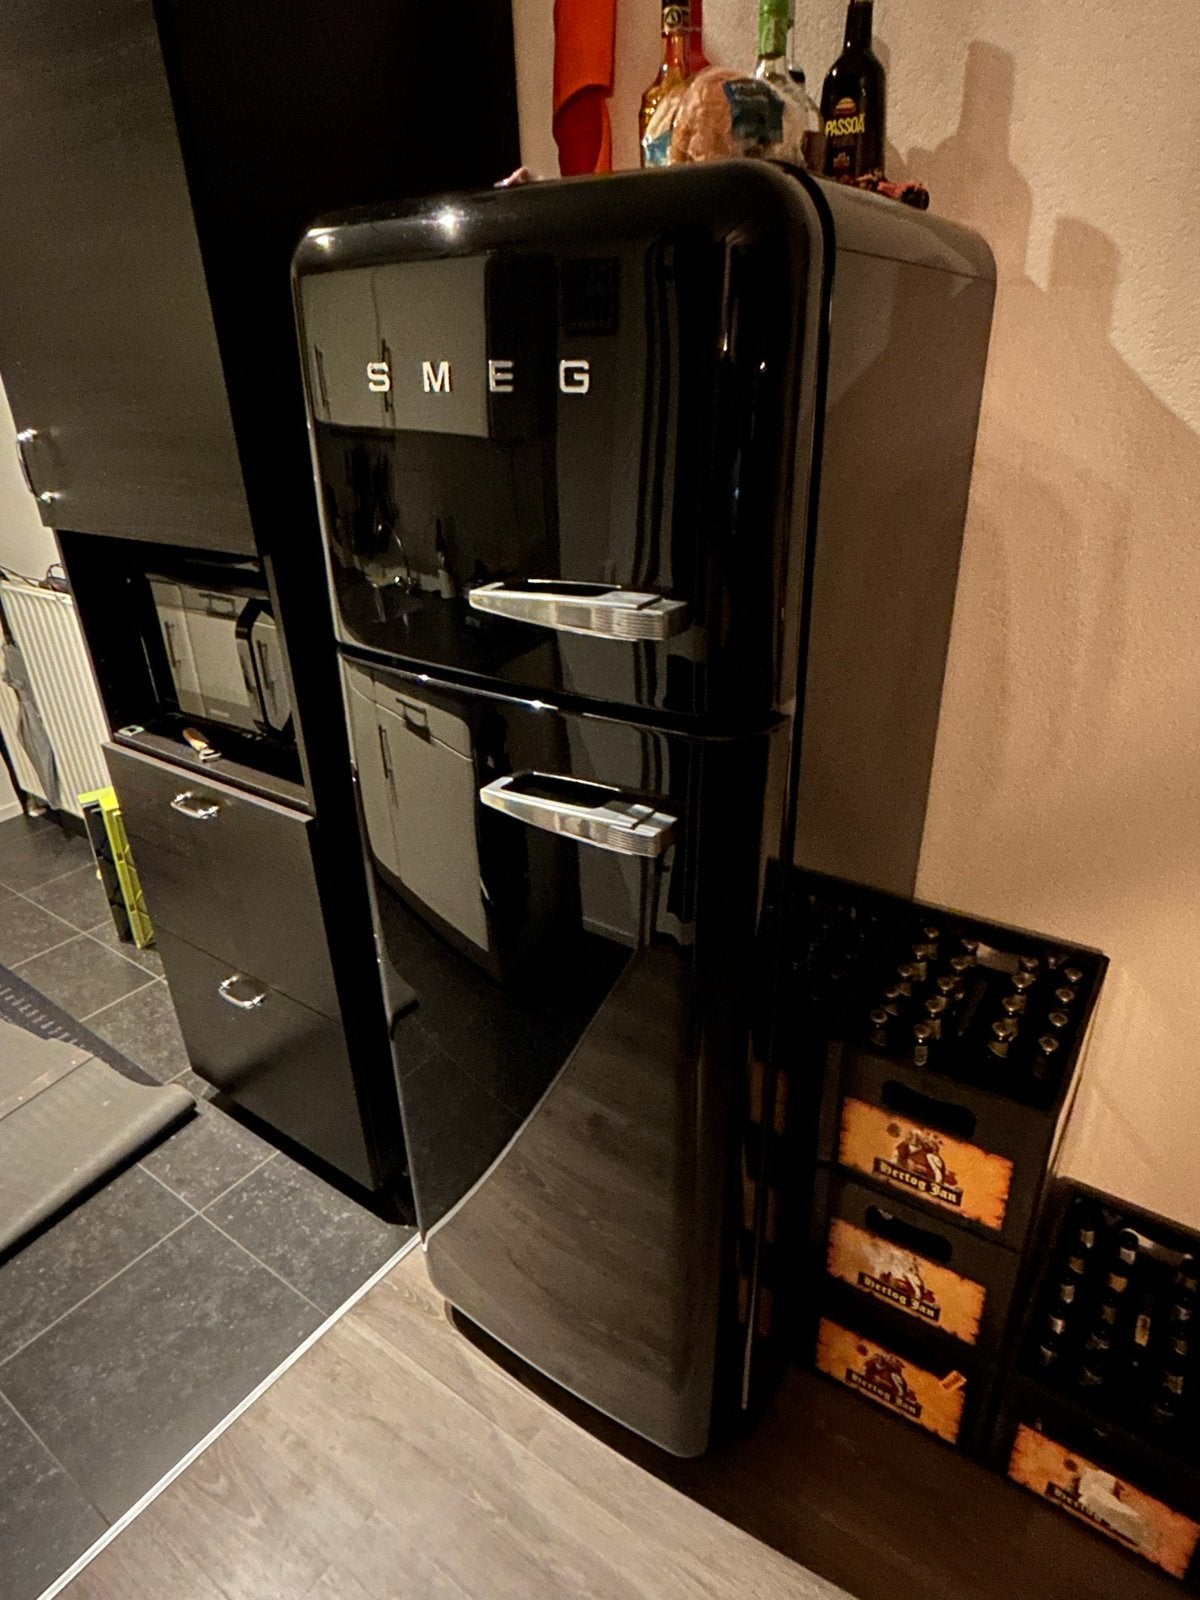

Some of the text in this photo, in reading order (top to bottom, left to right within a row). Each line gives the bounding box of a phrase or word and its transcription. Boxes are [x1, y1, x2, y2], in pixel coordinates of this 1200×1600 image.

[366, 359, 590, 394] SMEG
[879, 1160, 958, 1203] Hertog Jan
[910, 1298, 935, 1318] Jan
